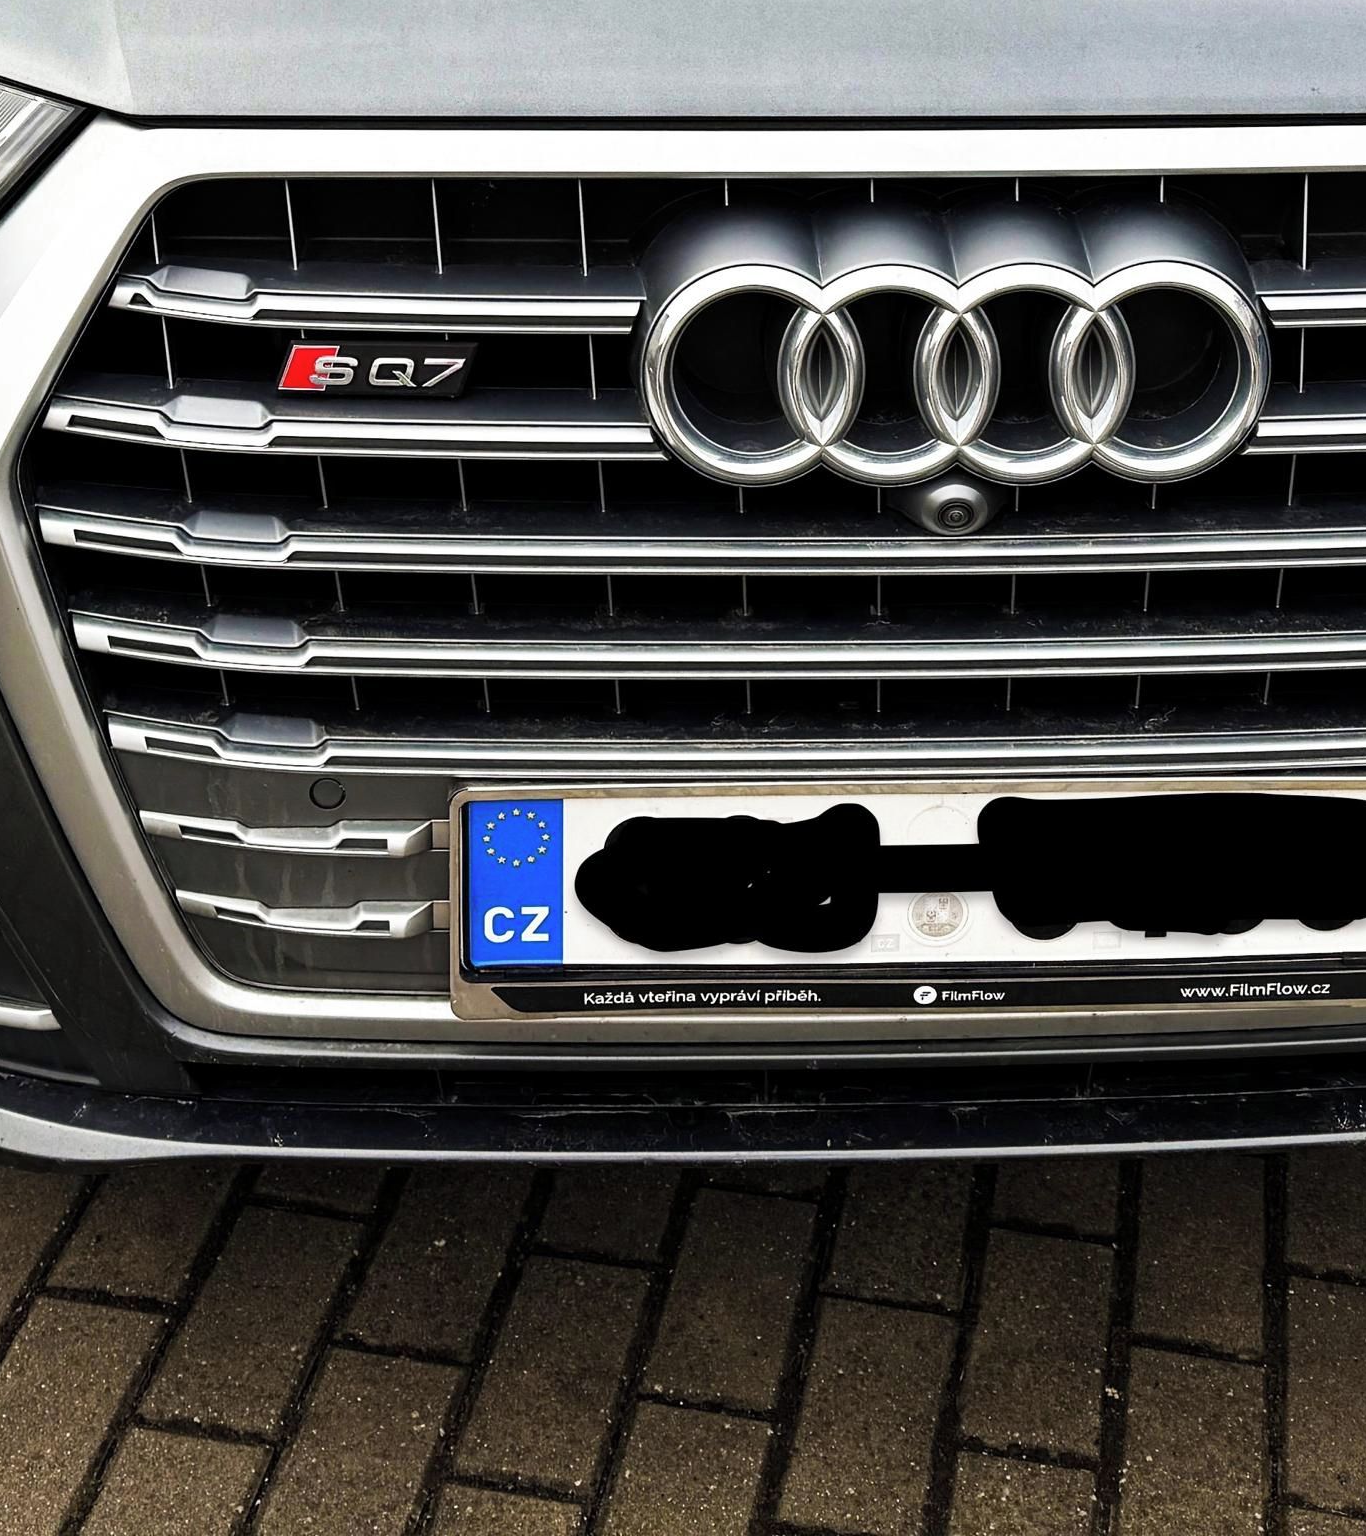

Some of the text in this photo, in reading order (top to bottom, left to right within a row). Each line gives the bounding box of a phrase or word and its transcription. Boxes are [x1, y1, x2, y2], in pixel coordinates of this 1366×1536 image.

[310, 356, 467, 388] SQ7
[484, 906, 550, 943] CZ
[584, 992, 635, 1005] Každá
[638, 990, 696, 1004] vteřina
[700, 989, 761, 1005] vypráví
[941, 990, 1005, 1001] FilmFlow
[1180, 982, 1331, 998] www.FilmFlow.cz
